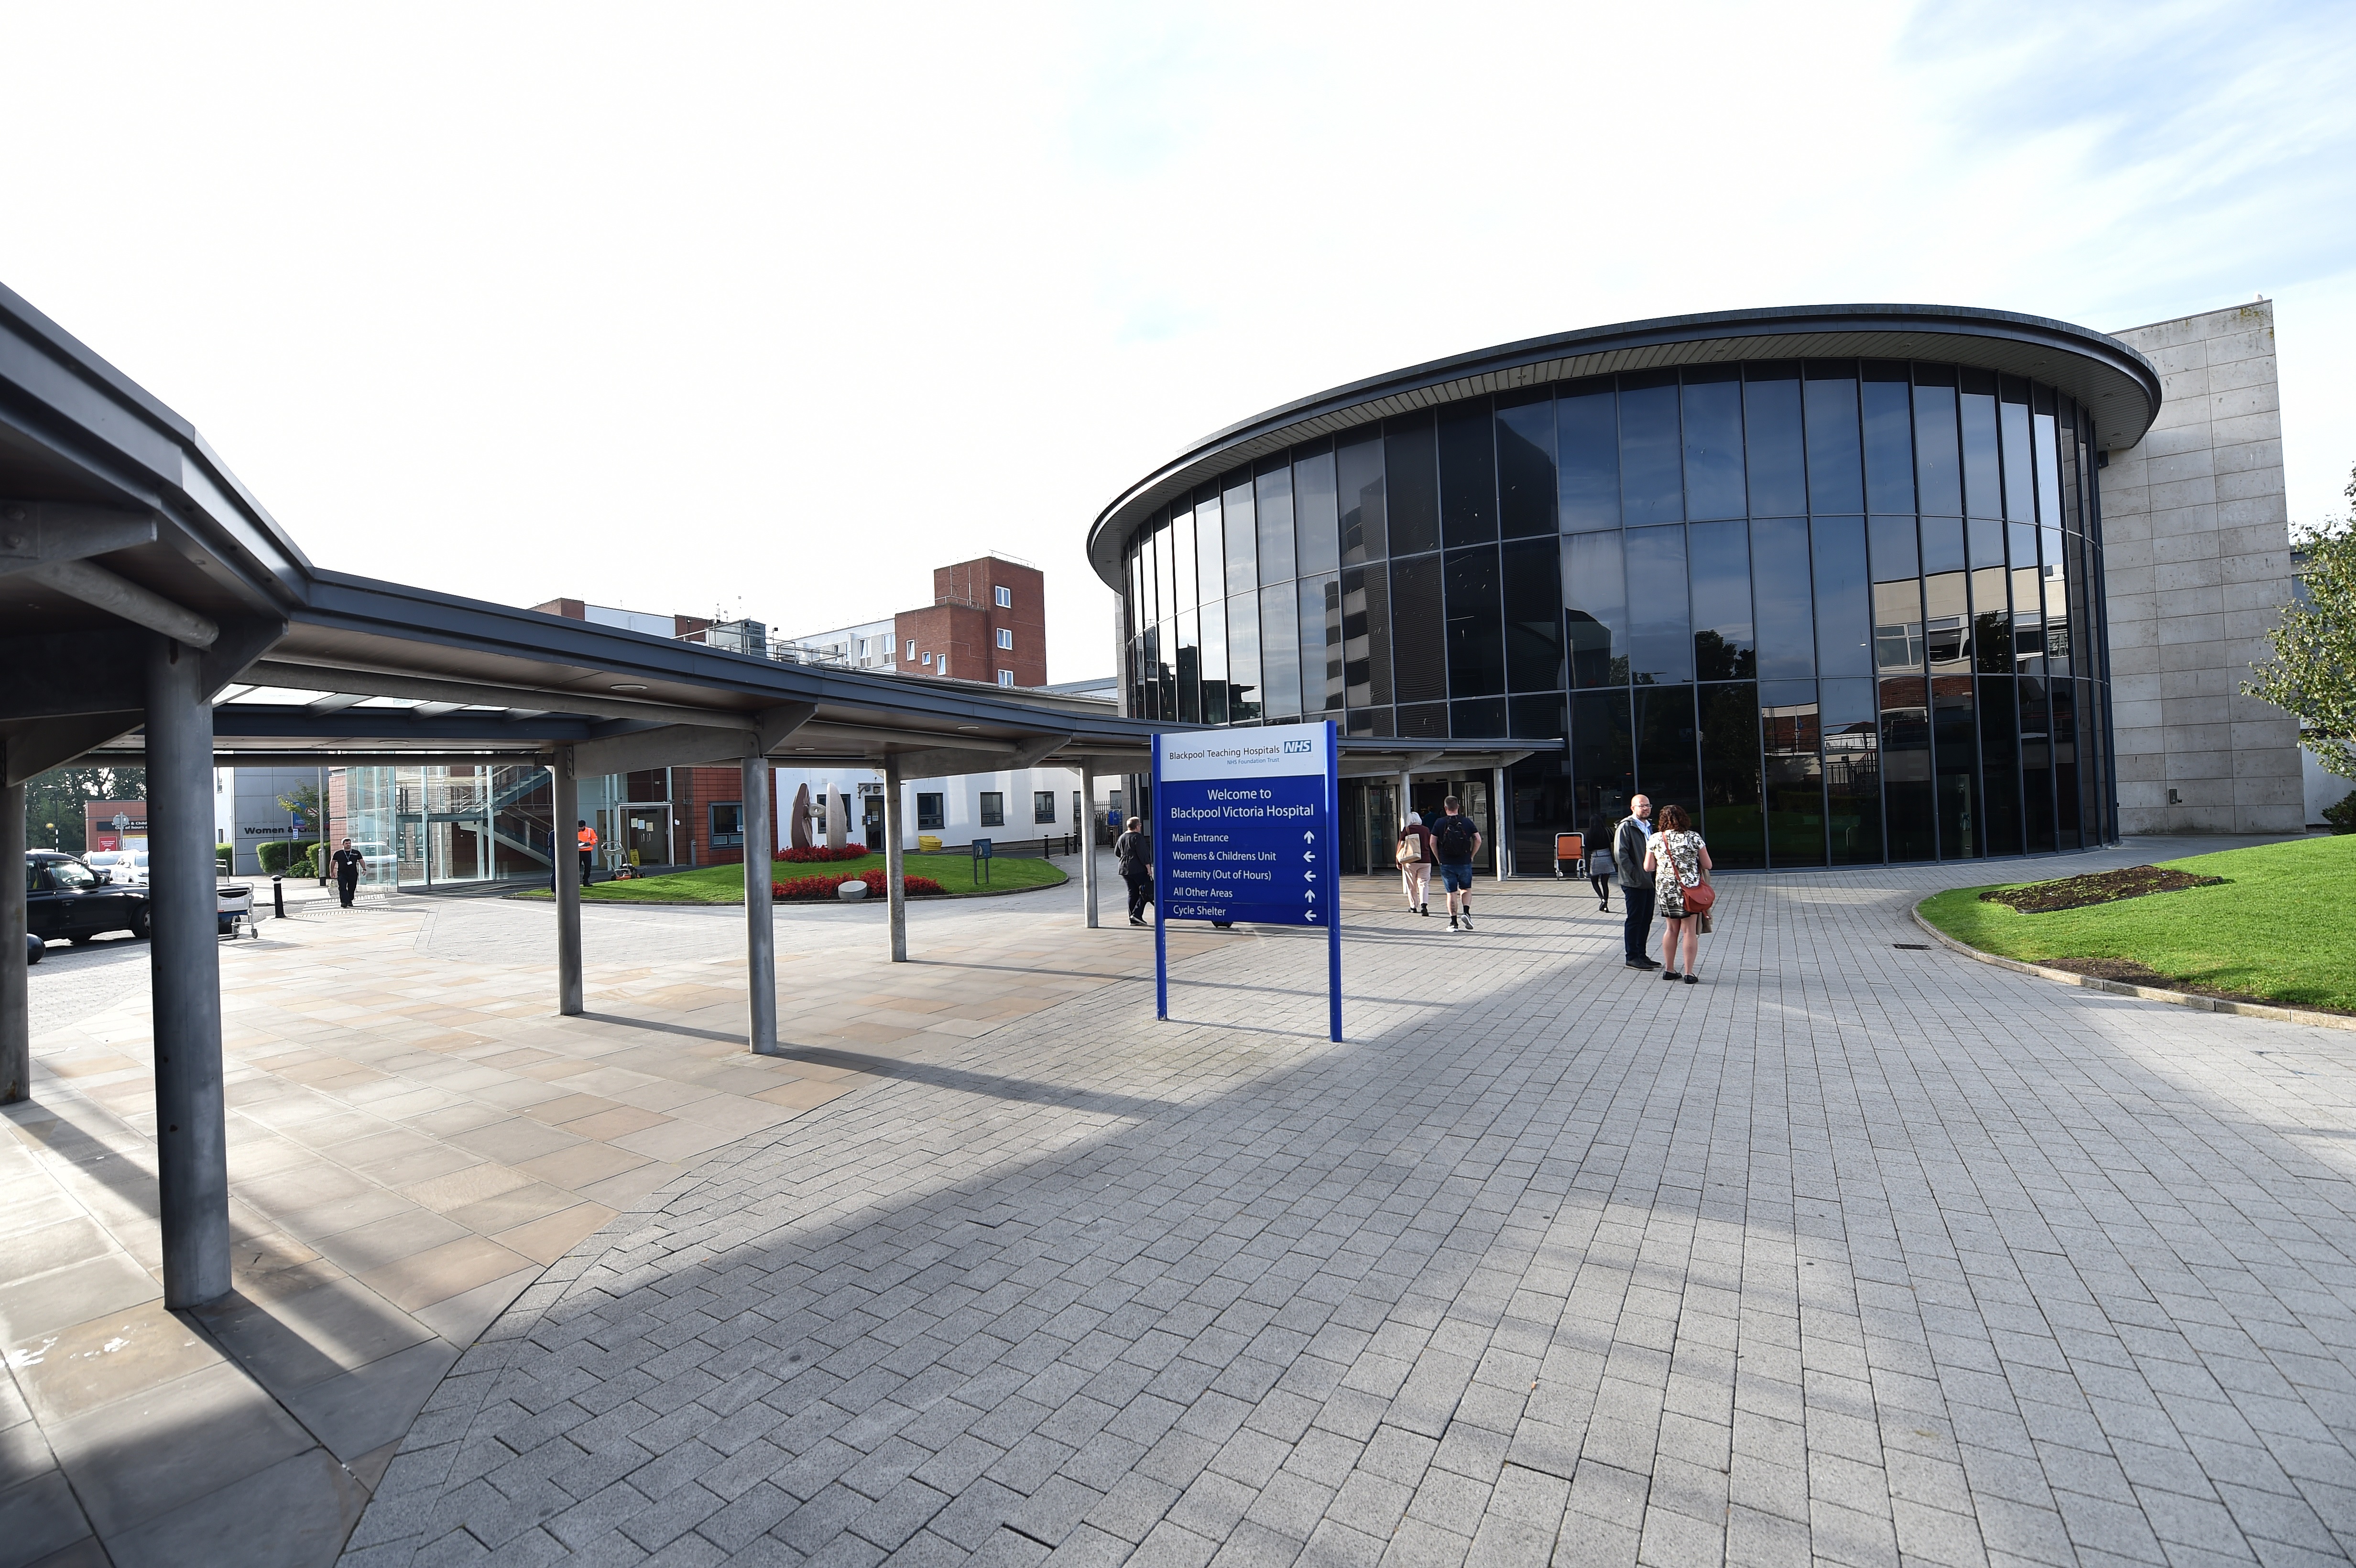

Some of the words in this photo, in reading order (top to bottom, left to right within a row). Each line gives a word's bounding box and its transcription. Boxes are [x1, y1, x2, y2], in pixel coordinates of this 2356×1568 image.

[1285, 740, 1310, 753] NHS
[1169, 750, 1205, 761] Blackpool
[1207, 748, 1241, 758] Teaching
[1243, 745, 1280, 756] Hospitals
[1207, 788, 1257, 800] Welcome
[1260, 789, 1272, 799] to
[1171, 806, 1221, 820] Blackpool
[1223, 806, 1264, 817] Victoria
[1266, 804, 1314, 819] Hospital
[1172, 833, 1191, 842] Main
[1194, 834, 1229, 842] Entrance
[1173, 852, 1207, 860] Womens
[1209, 852, 1215, 860] &
[1216, 851, 1256, 861] Childrens
[1258, 851, 1276, 861] Unit
[1173, 869, 1211, 881] Maternity
[1213, 870, 1231, 881] (Out
[1233, 870, 1242, 879] of
[1243, 871, 1272, 881] Hours)
[1173, 887, 1184, 896] All
[1185, 888, 1208, 897] Other
[1210, 888, 1233, 898] Areas
[1173, 905, 1195, 917] Cycle
[1197, 906, 1226, 916] Shelter
